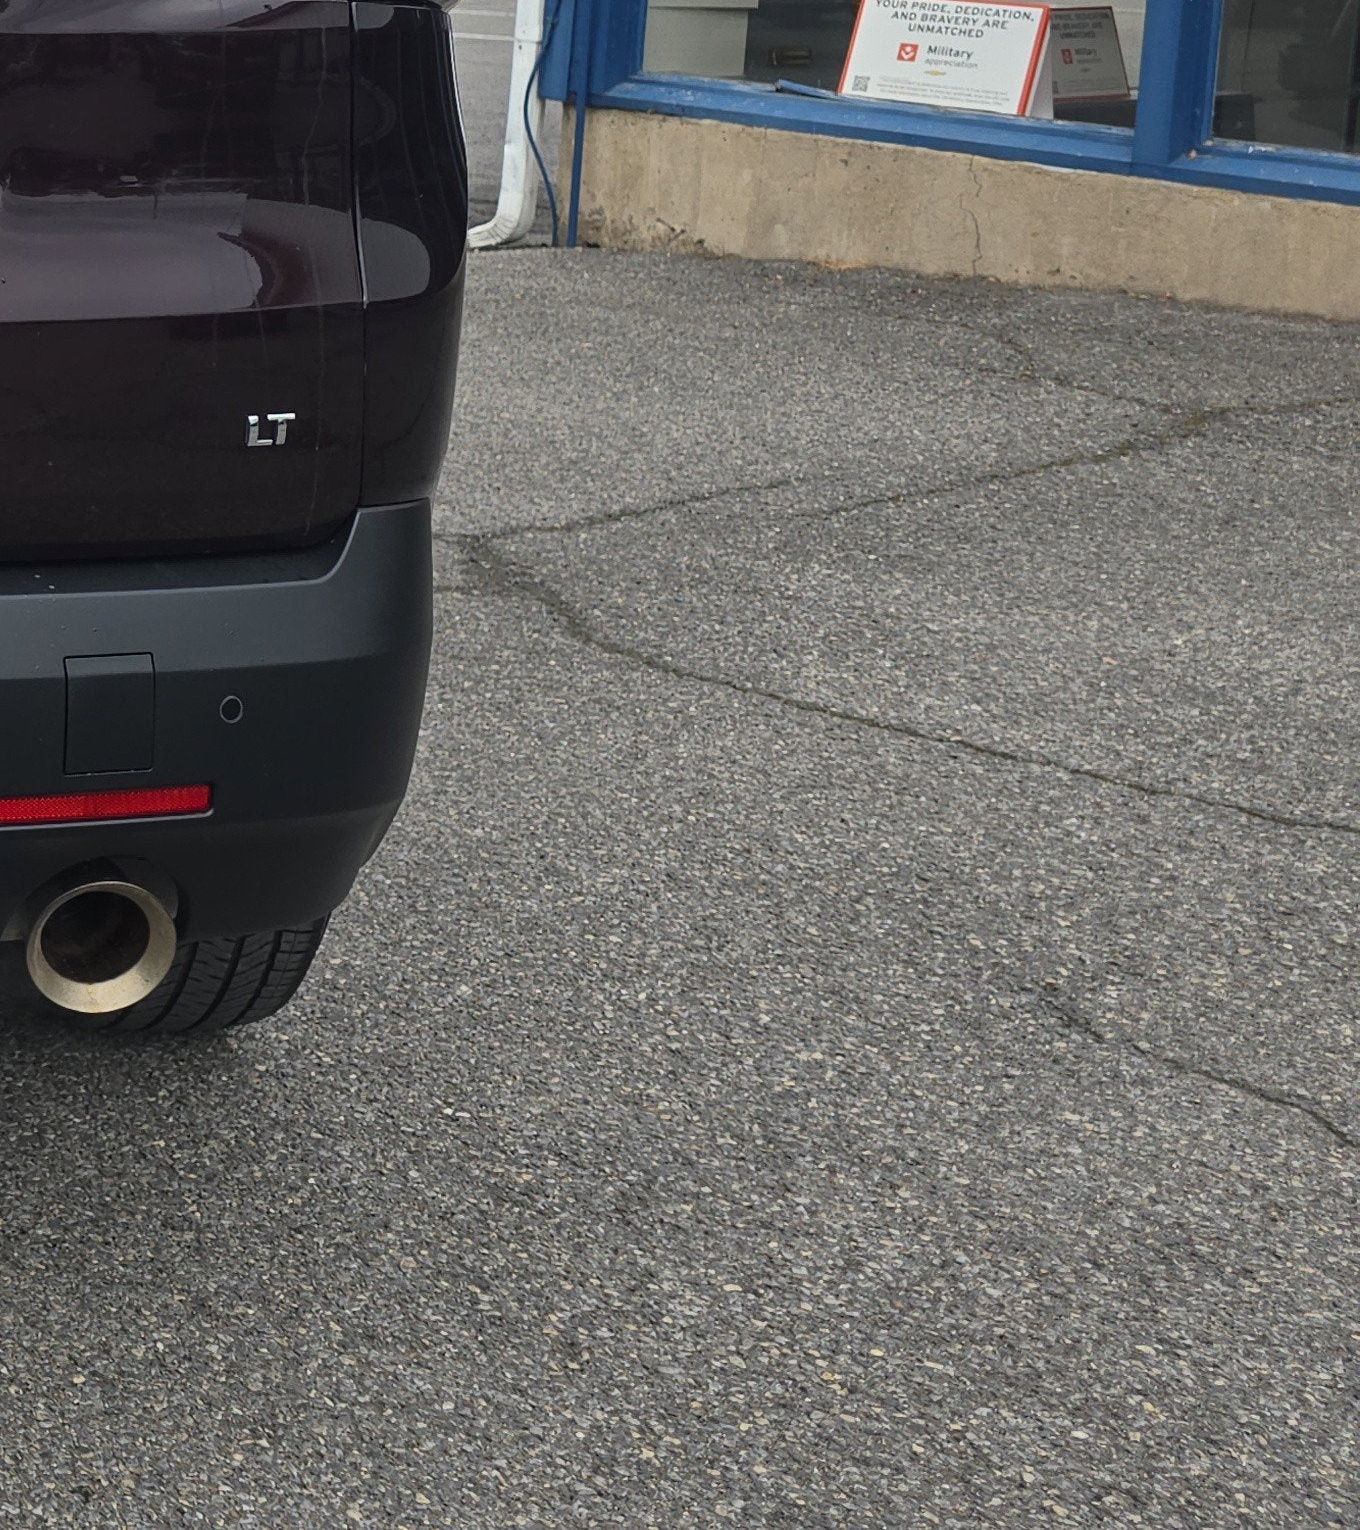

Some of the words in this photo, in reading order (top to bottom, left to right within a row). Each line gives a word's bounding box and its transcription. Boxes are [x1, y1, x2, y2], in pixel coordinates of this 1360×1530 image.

[891, 10, 917, 21] AND
[920, 13, 979, 27] BRAVERY
[981, 19, 1010, 31] ARE
[907, 22, 985, 39] UNMATCHED
[926, 44, 974, 61] Military
[246, 412, 296, 447] LT
